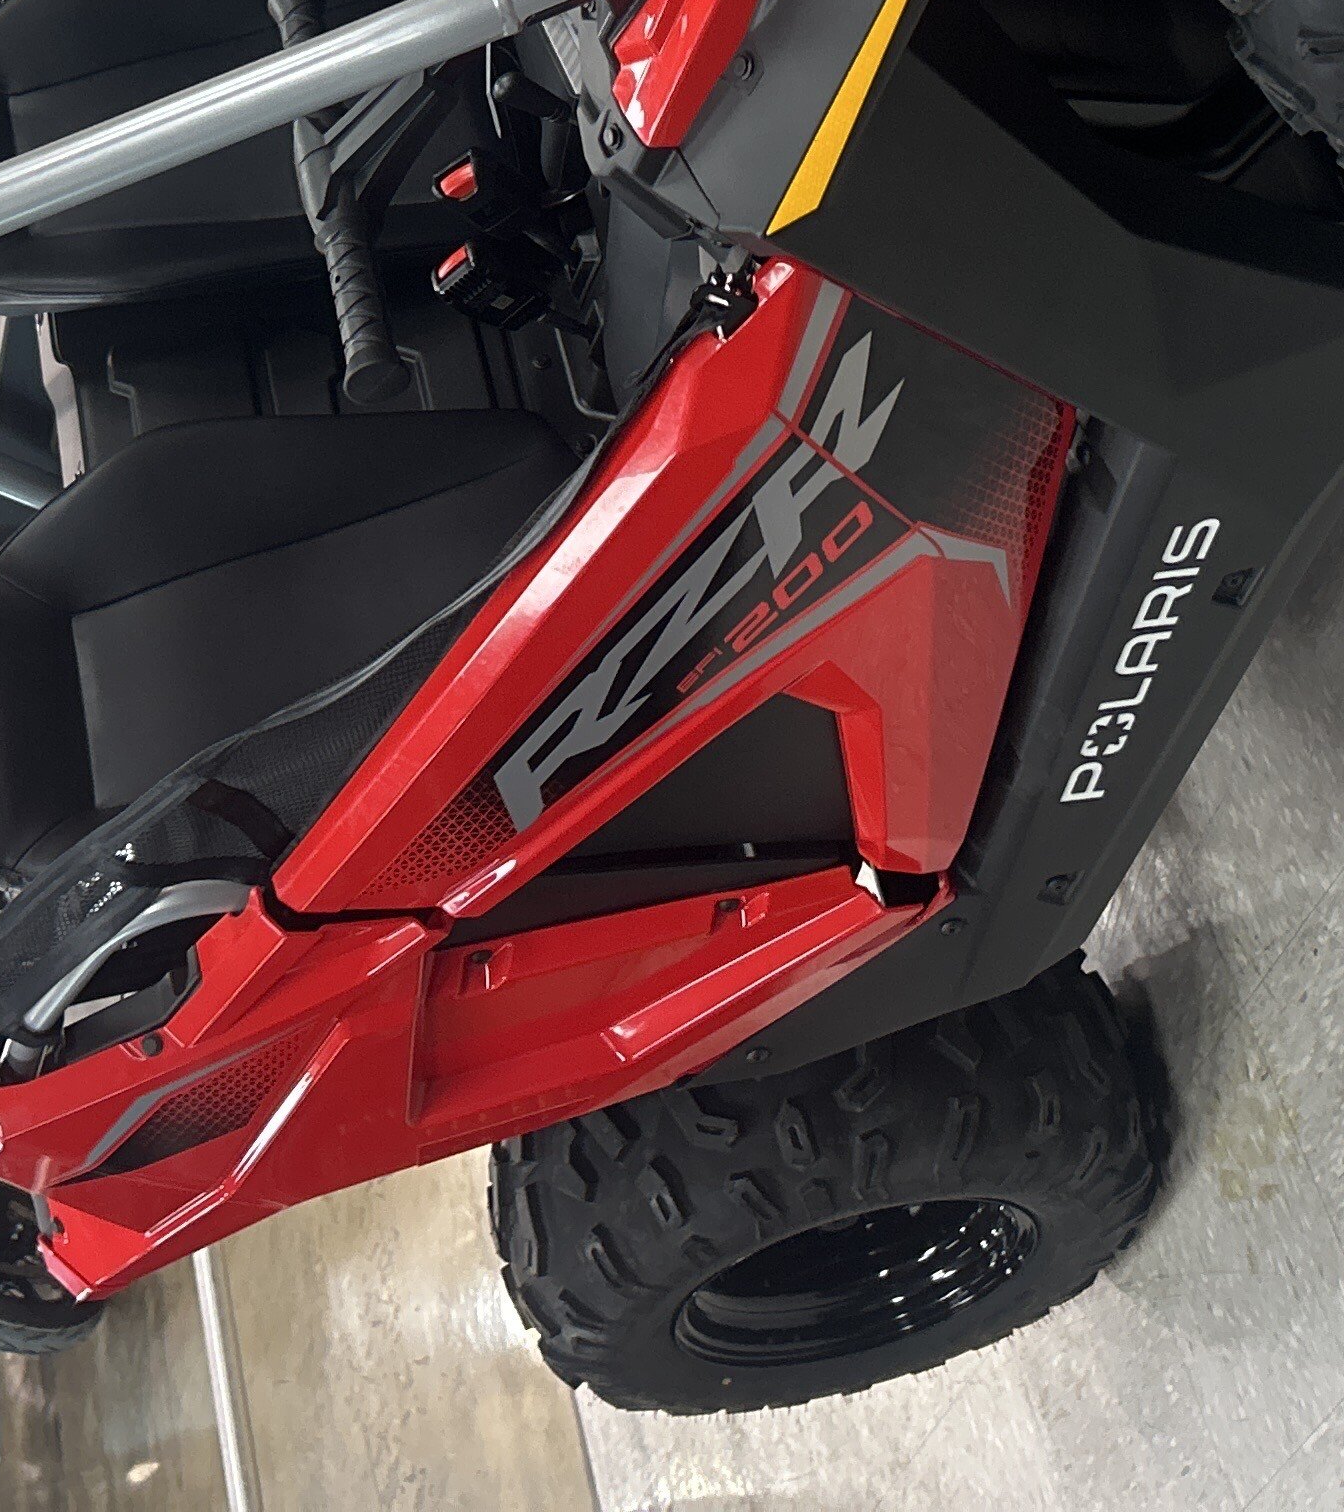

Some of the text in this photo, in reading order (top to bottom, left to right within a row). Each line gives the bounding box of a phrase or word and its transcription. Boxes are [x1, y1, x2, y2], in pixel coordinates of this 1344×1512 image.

[493, 330, 905, 834] RZR
[725, 500, 874, 655] 200
[1059, 518, 1220, 803] POLARIS
